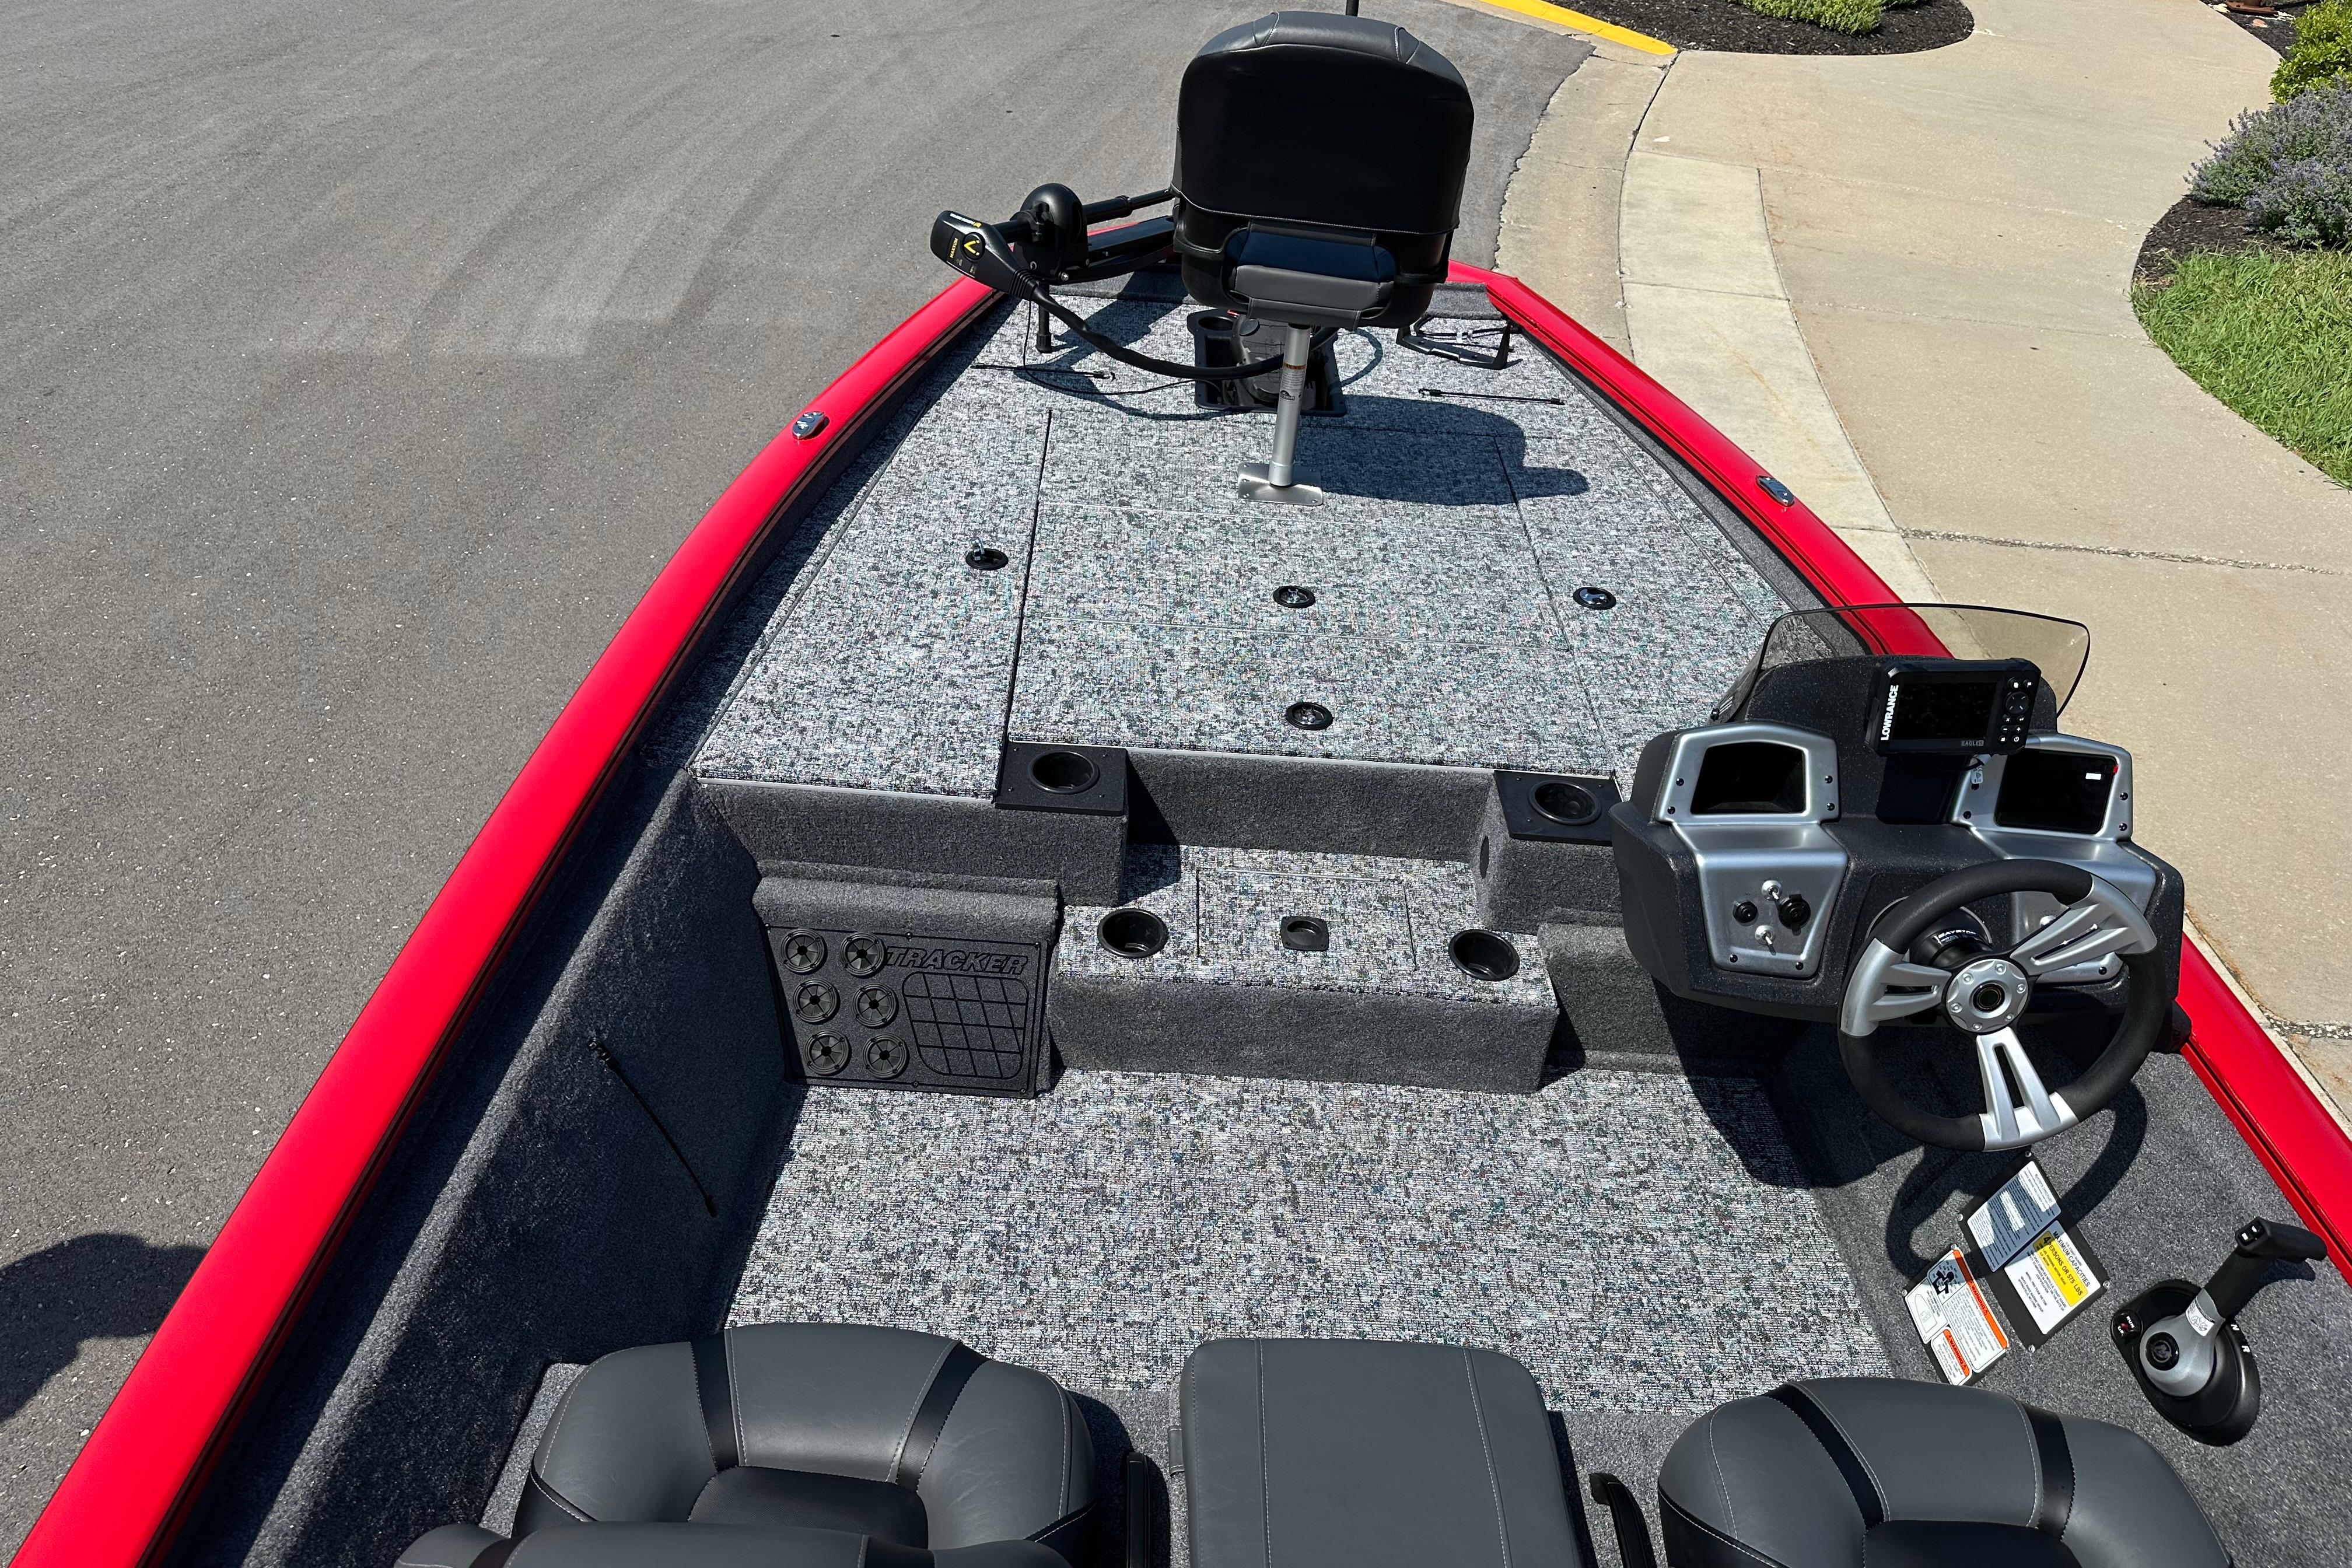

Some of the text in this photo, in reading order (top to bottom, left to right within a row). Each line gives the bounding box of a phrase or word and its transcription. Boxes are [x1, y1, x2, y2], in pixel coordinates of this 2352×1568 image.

[1881, 685, 1899, 740] LOWRANCE
[887, 946, 1028, 975] TRACKER
[2046, 1242, 2064, 1266] PERSONS
[2061, 1265, 2070, 1275] OR
[2067, 1273, 2076, 1284] 575
[2073, 1283, 2083, 1296] LBS
[2052, 1231, 2090, 1287] MAXIMUM CAPACITIES
[2126, 1316, 2134, 1328] RUN
